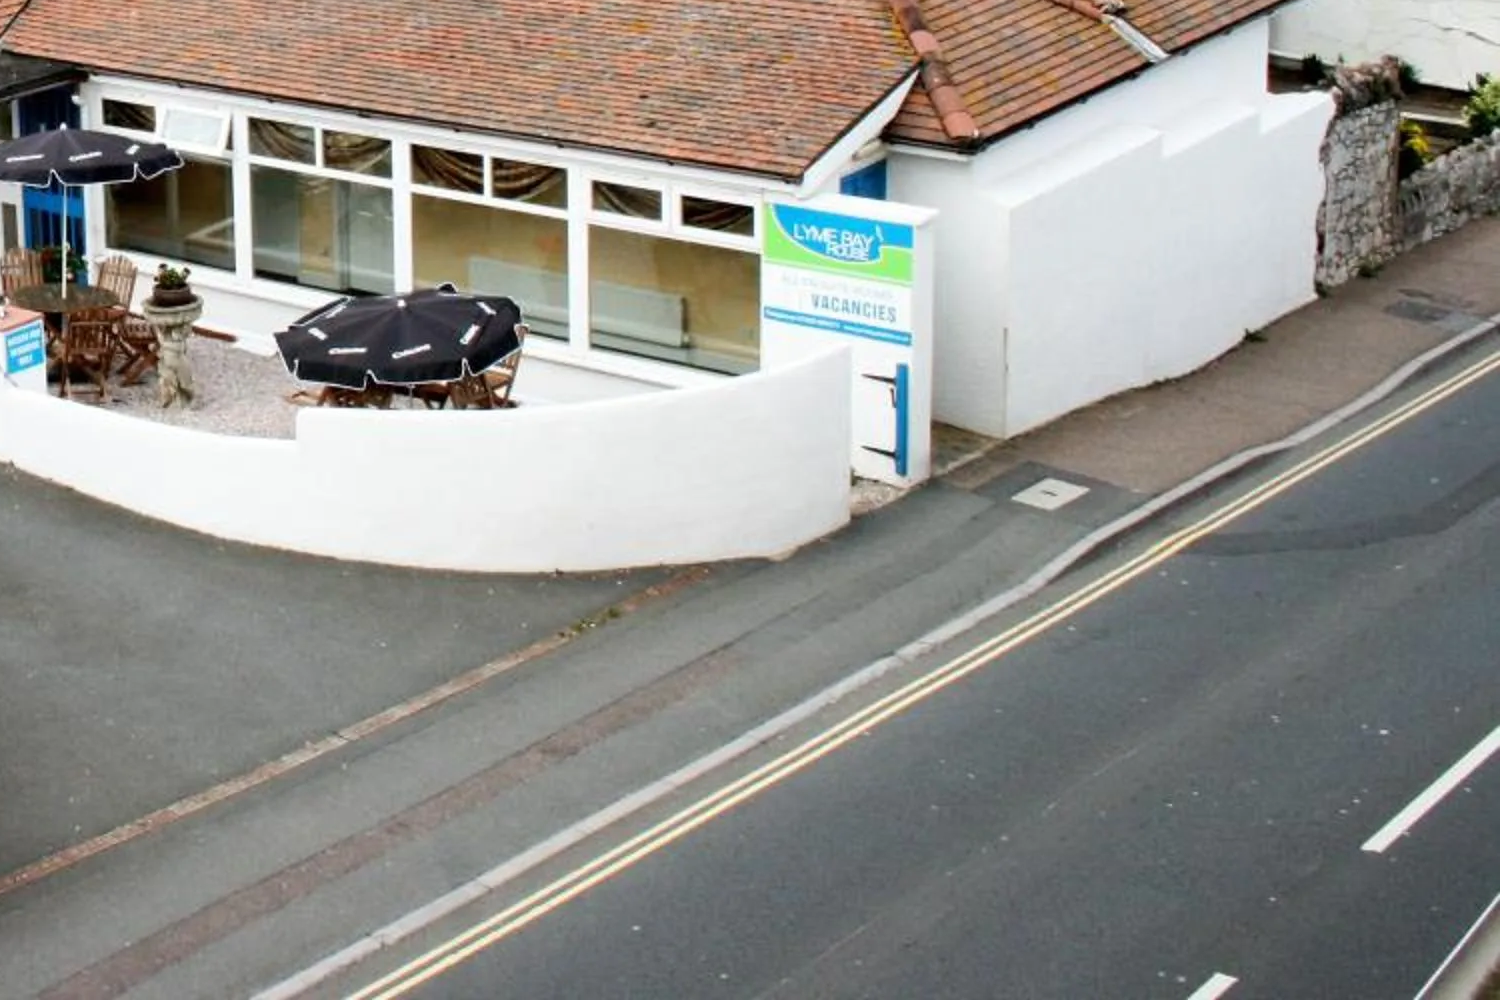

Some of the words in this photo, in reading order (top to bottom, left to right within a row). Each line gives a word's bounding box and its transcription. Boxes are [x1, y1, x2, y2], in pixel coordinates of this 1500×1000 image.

[793, 223, 837, 245] LYME
[841, 229, 874, 248] BAY
[810, 292, 898, 323] VACANCIES
